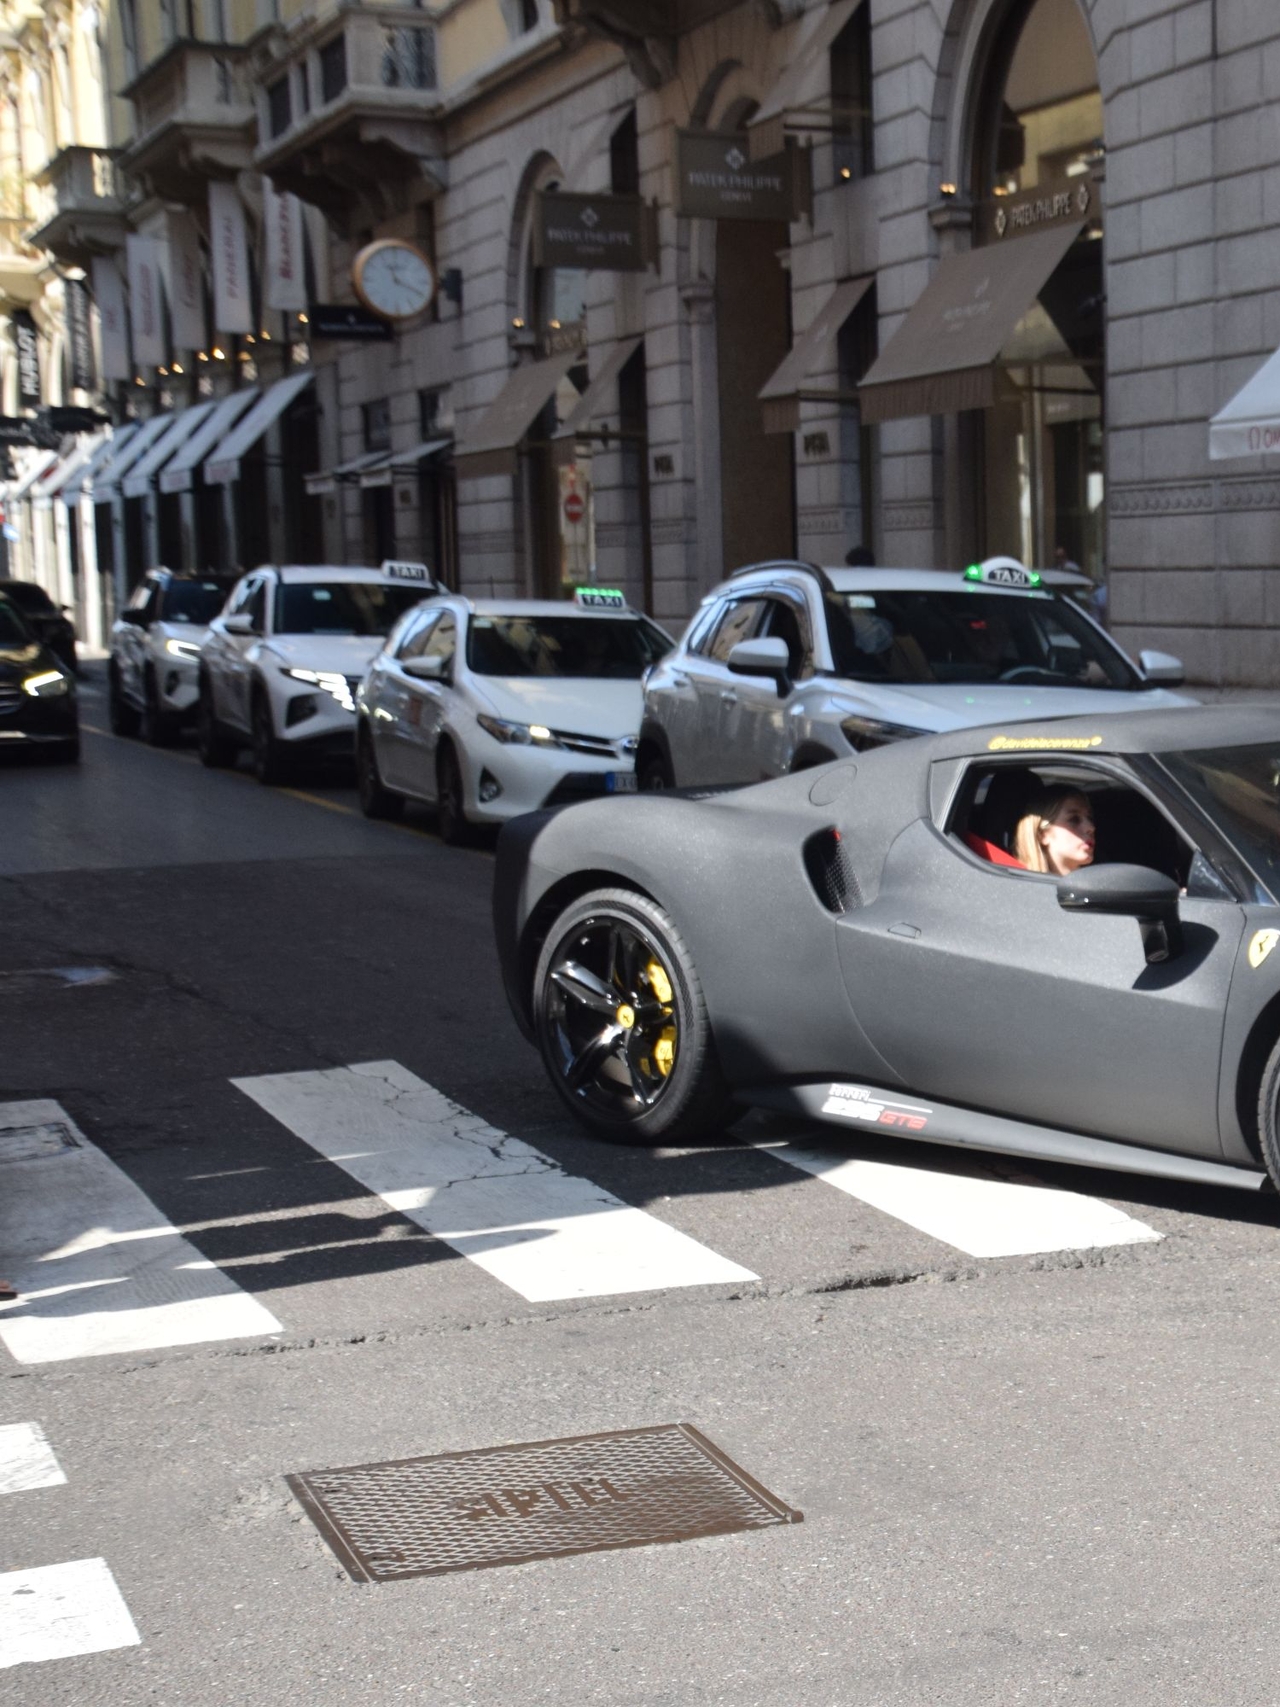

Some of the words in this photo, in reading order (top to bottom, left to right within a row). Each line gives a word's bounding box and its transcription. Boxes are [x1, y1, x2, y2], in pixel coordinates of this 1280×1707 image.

[394, 565, 425, 580] TAXI
[993, 569, 1026, 585] TAXI
[584, 594, 622, 608] TAXI
[879, 1110, 924, 1130] GTB
